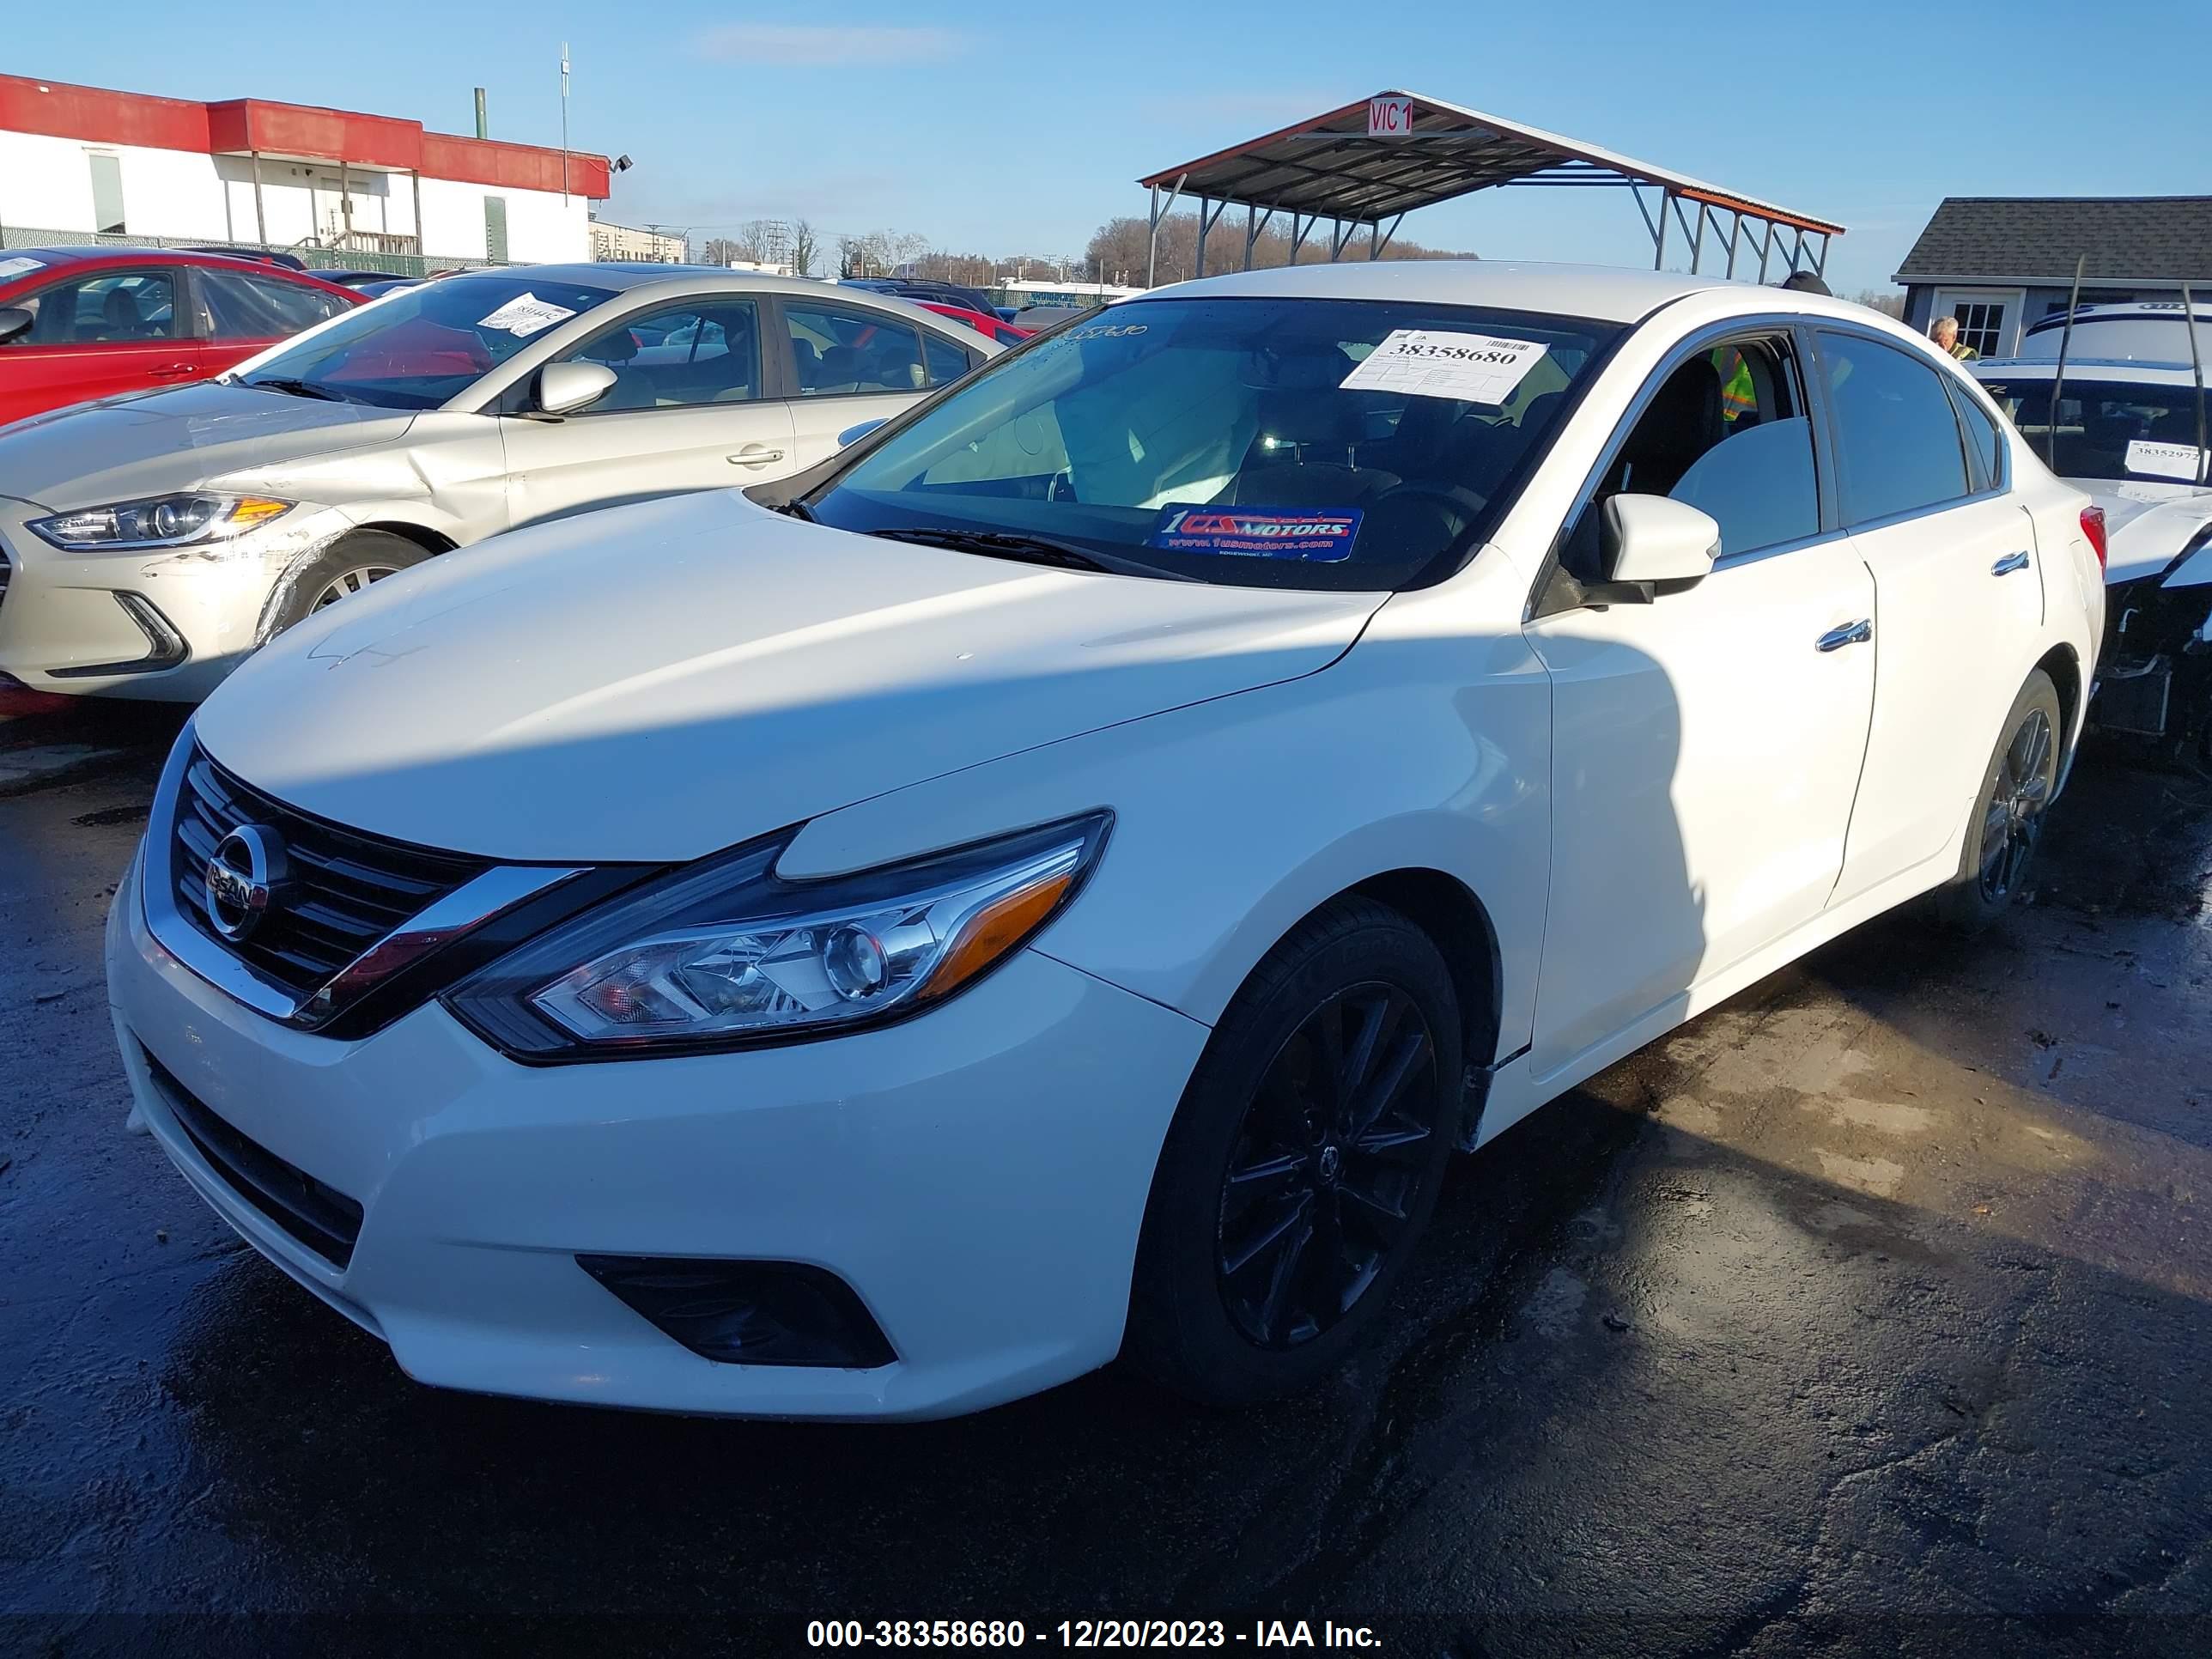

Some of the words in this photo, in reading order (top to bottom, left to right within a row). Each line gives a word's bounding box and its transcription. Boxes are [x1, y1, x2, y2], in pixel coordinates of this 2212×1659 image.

[1371, 102, 1399, 131] VIC
[1402, 102, 1412, 130] 1
[1389, 343, 1517, 366] 38358680
[2136, 447, 2199, 460] 38352972
[1242, 524, 1348, 537] MOTORS
[1168, 538, 1334, 551] www.1usmotors.com
